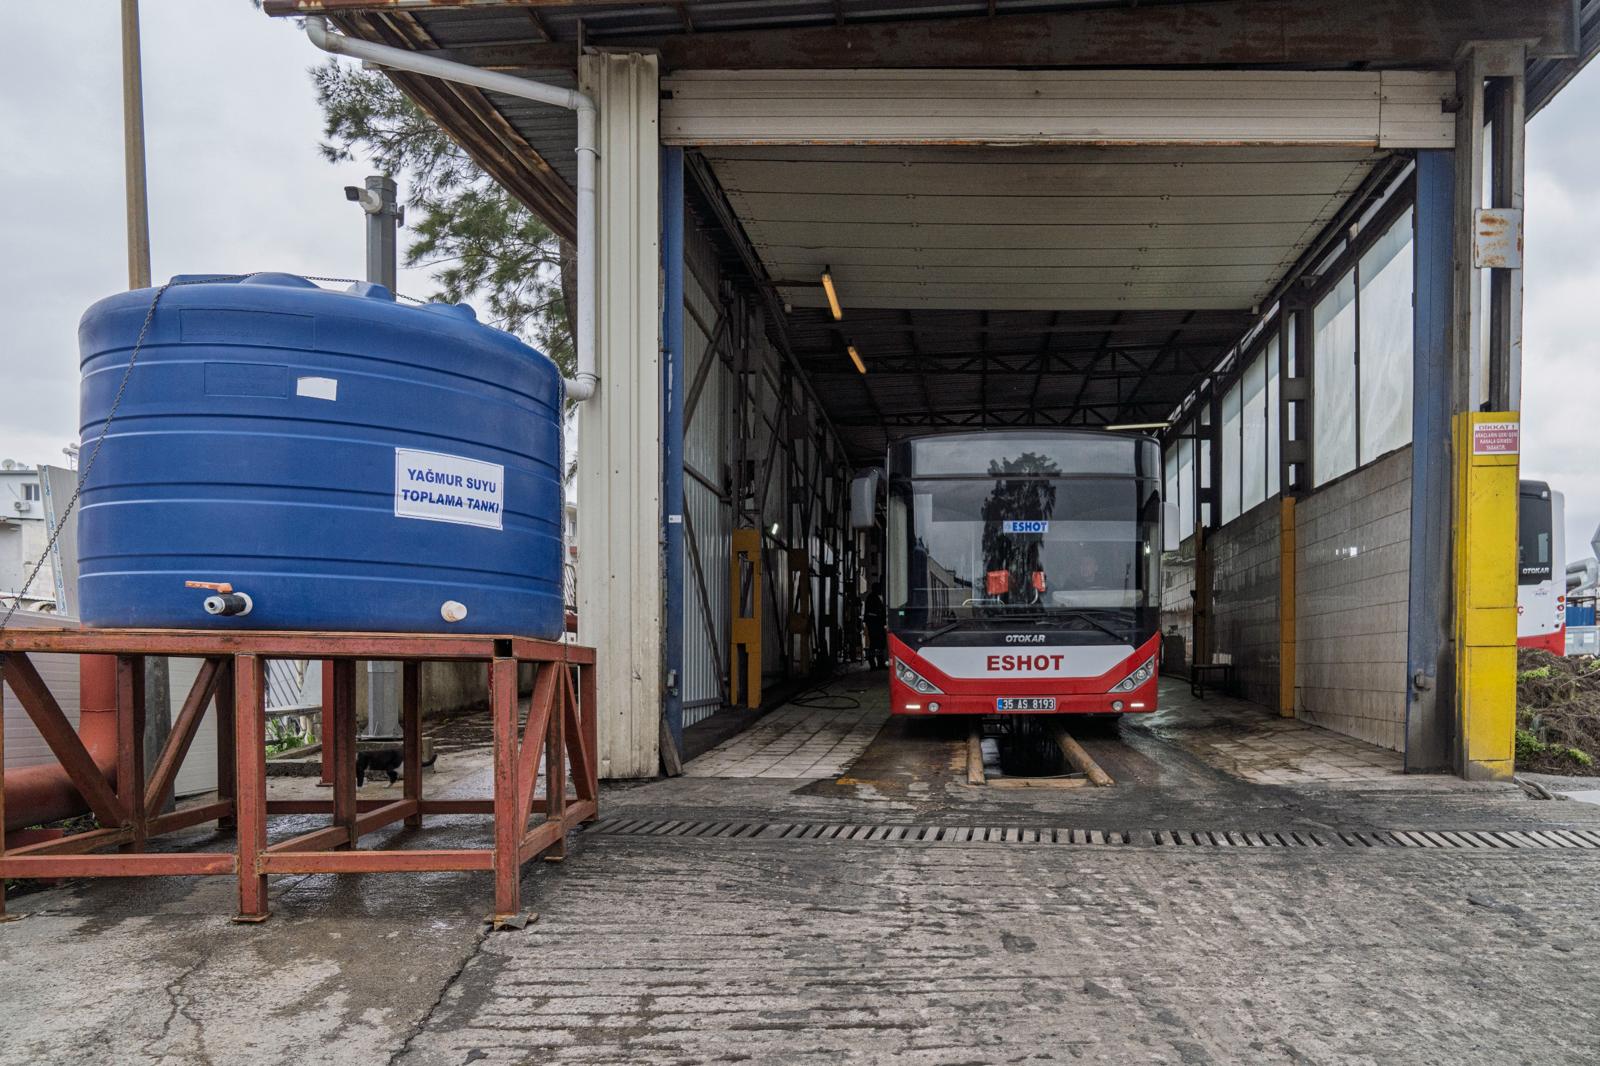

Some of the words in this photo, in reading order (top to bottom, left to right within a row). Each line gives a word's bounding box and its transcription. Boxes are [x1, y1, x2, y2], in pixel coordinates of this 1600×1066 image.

[407, 468, 463, 488] YAĞMUR
[466, 477, 496, 494] SUYU
[401, 489, 463, 508] TOPLAMA
[467, 497, 500, 514] TANKI
[1013, 521, 1047, 532] ESHOT
[1005, 634, 1046, 643] OTOKAR
[987, 654, 1065, 671] ESHOT
[1003, 699, 1014, 709] 35
[1017, 699, 1028, 709] AS
[1032, 699, 1054, 709] 8193
